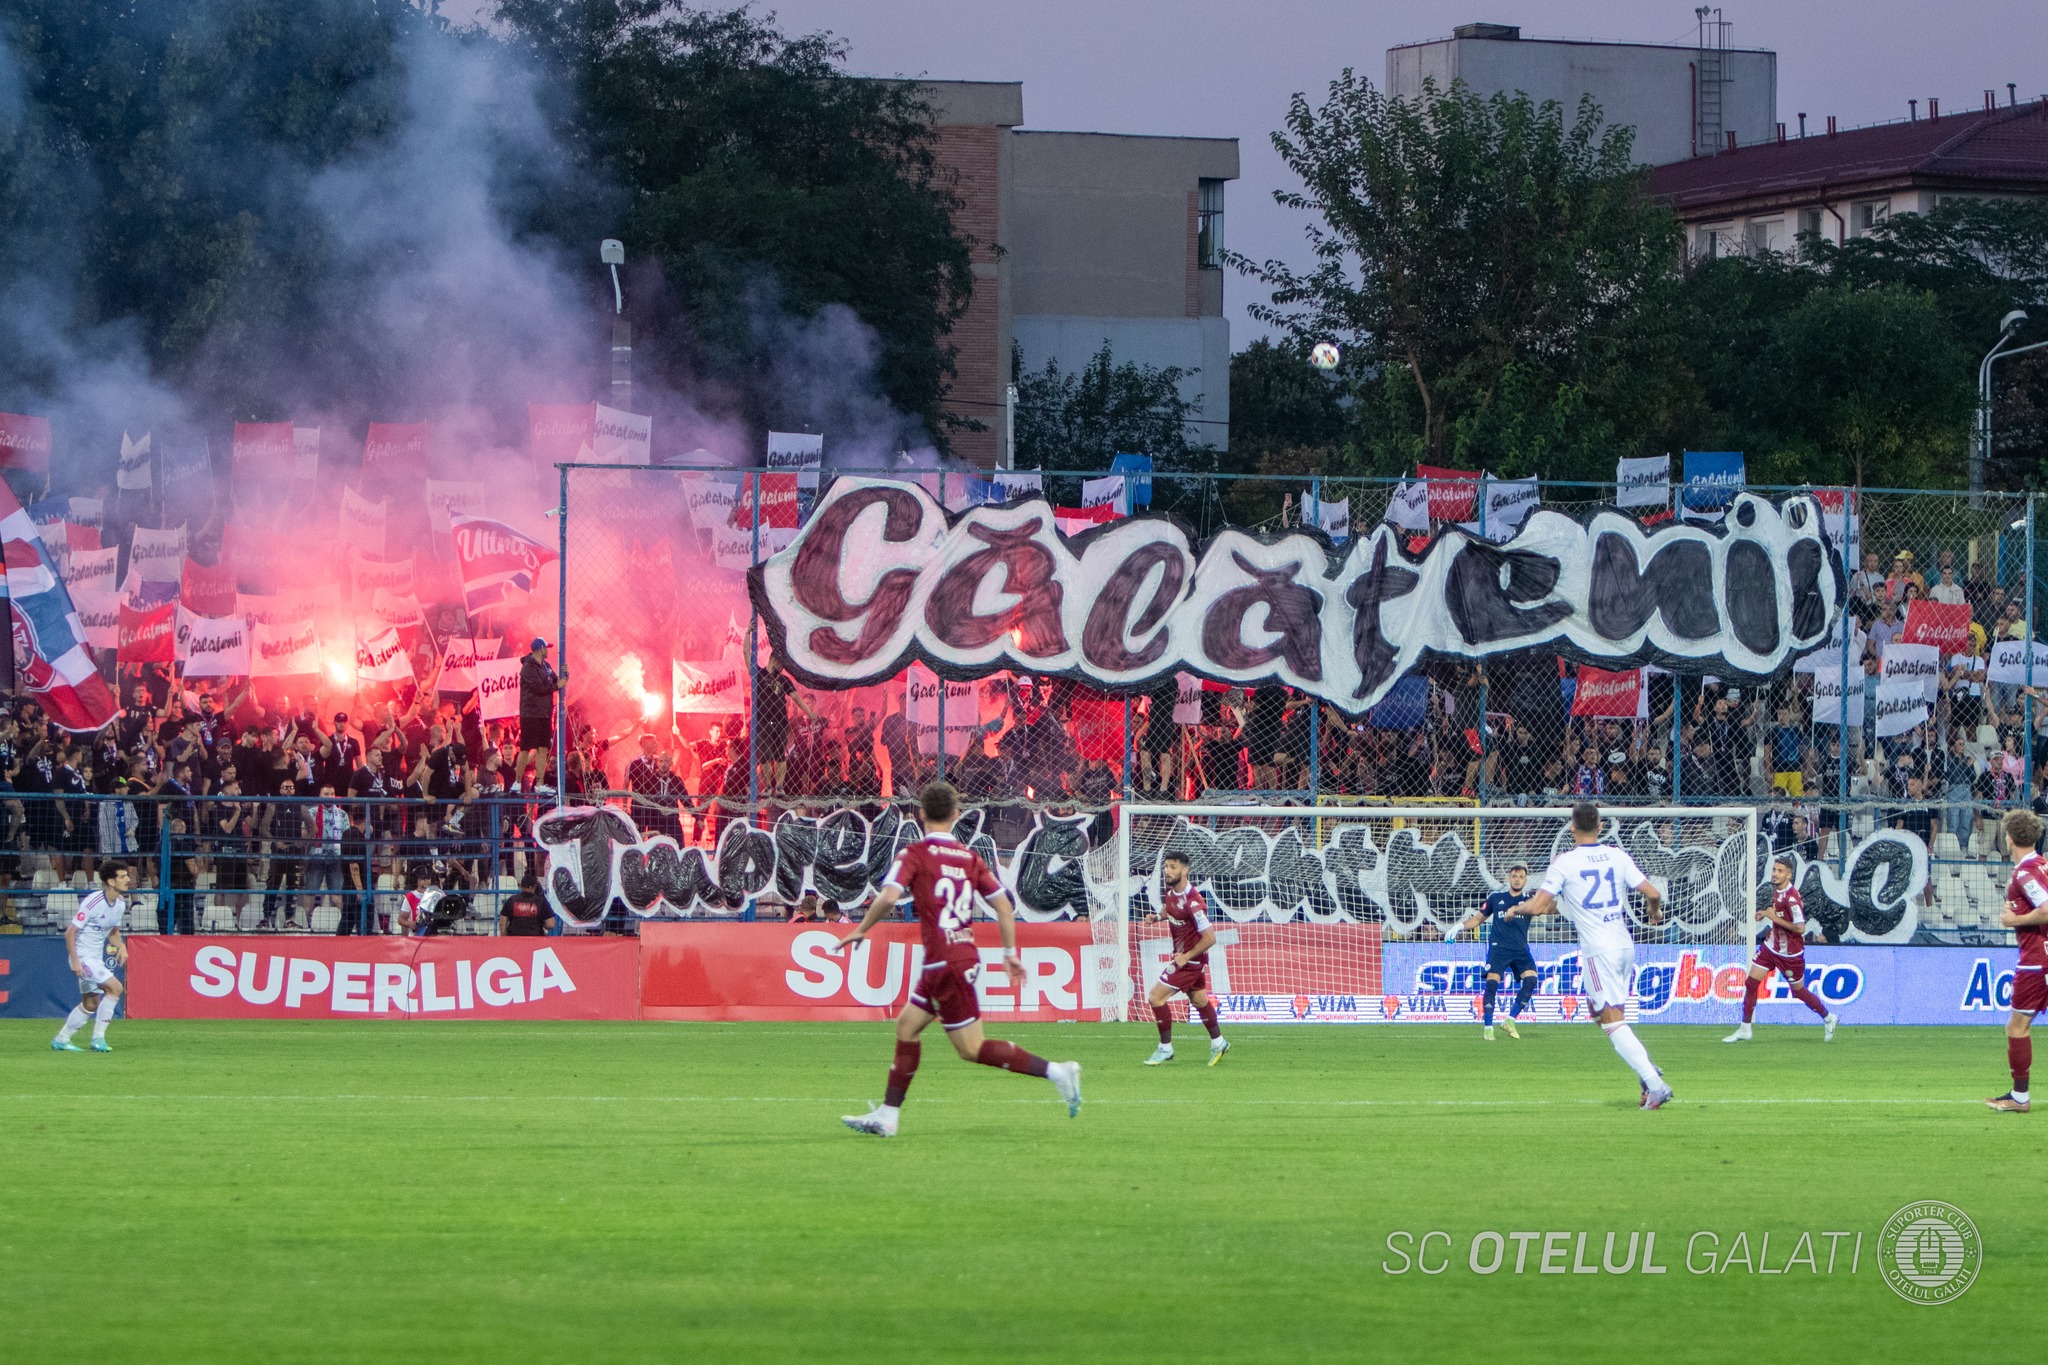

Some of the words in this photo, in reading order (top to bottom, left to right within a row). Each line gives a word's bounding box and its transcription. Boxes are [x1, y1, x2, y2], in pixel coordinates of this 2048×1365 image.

[457, 527, 540, 570] Ultras
[190, 630, 242, 658] Galatenii
[1885, 659, 1938, 678] Galatenii
[910, 681, 972, 702] Galtenii
[1587, 854, 1609, 862] TELES
[1579, 867, 1619, 909] 21
[934, 877, 972, 929] 24
[190, 945, 577, 1013] SUPERLIGA
[1226, 996, 1267, 1012] VIM
[1317, 996, 1357, 1012] VIM
[1406, 996, 1447, 1012] VIM
